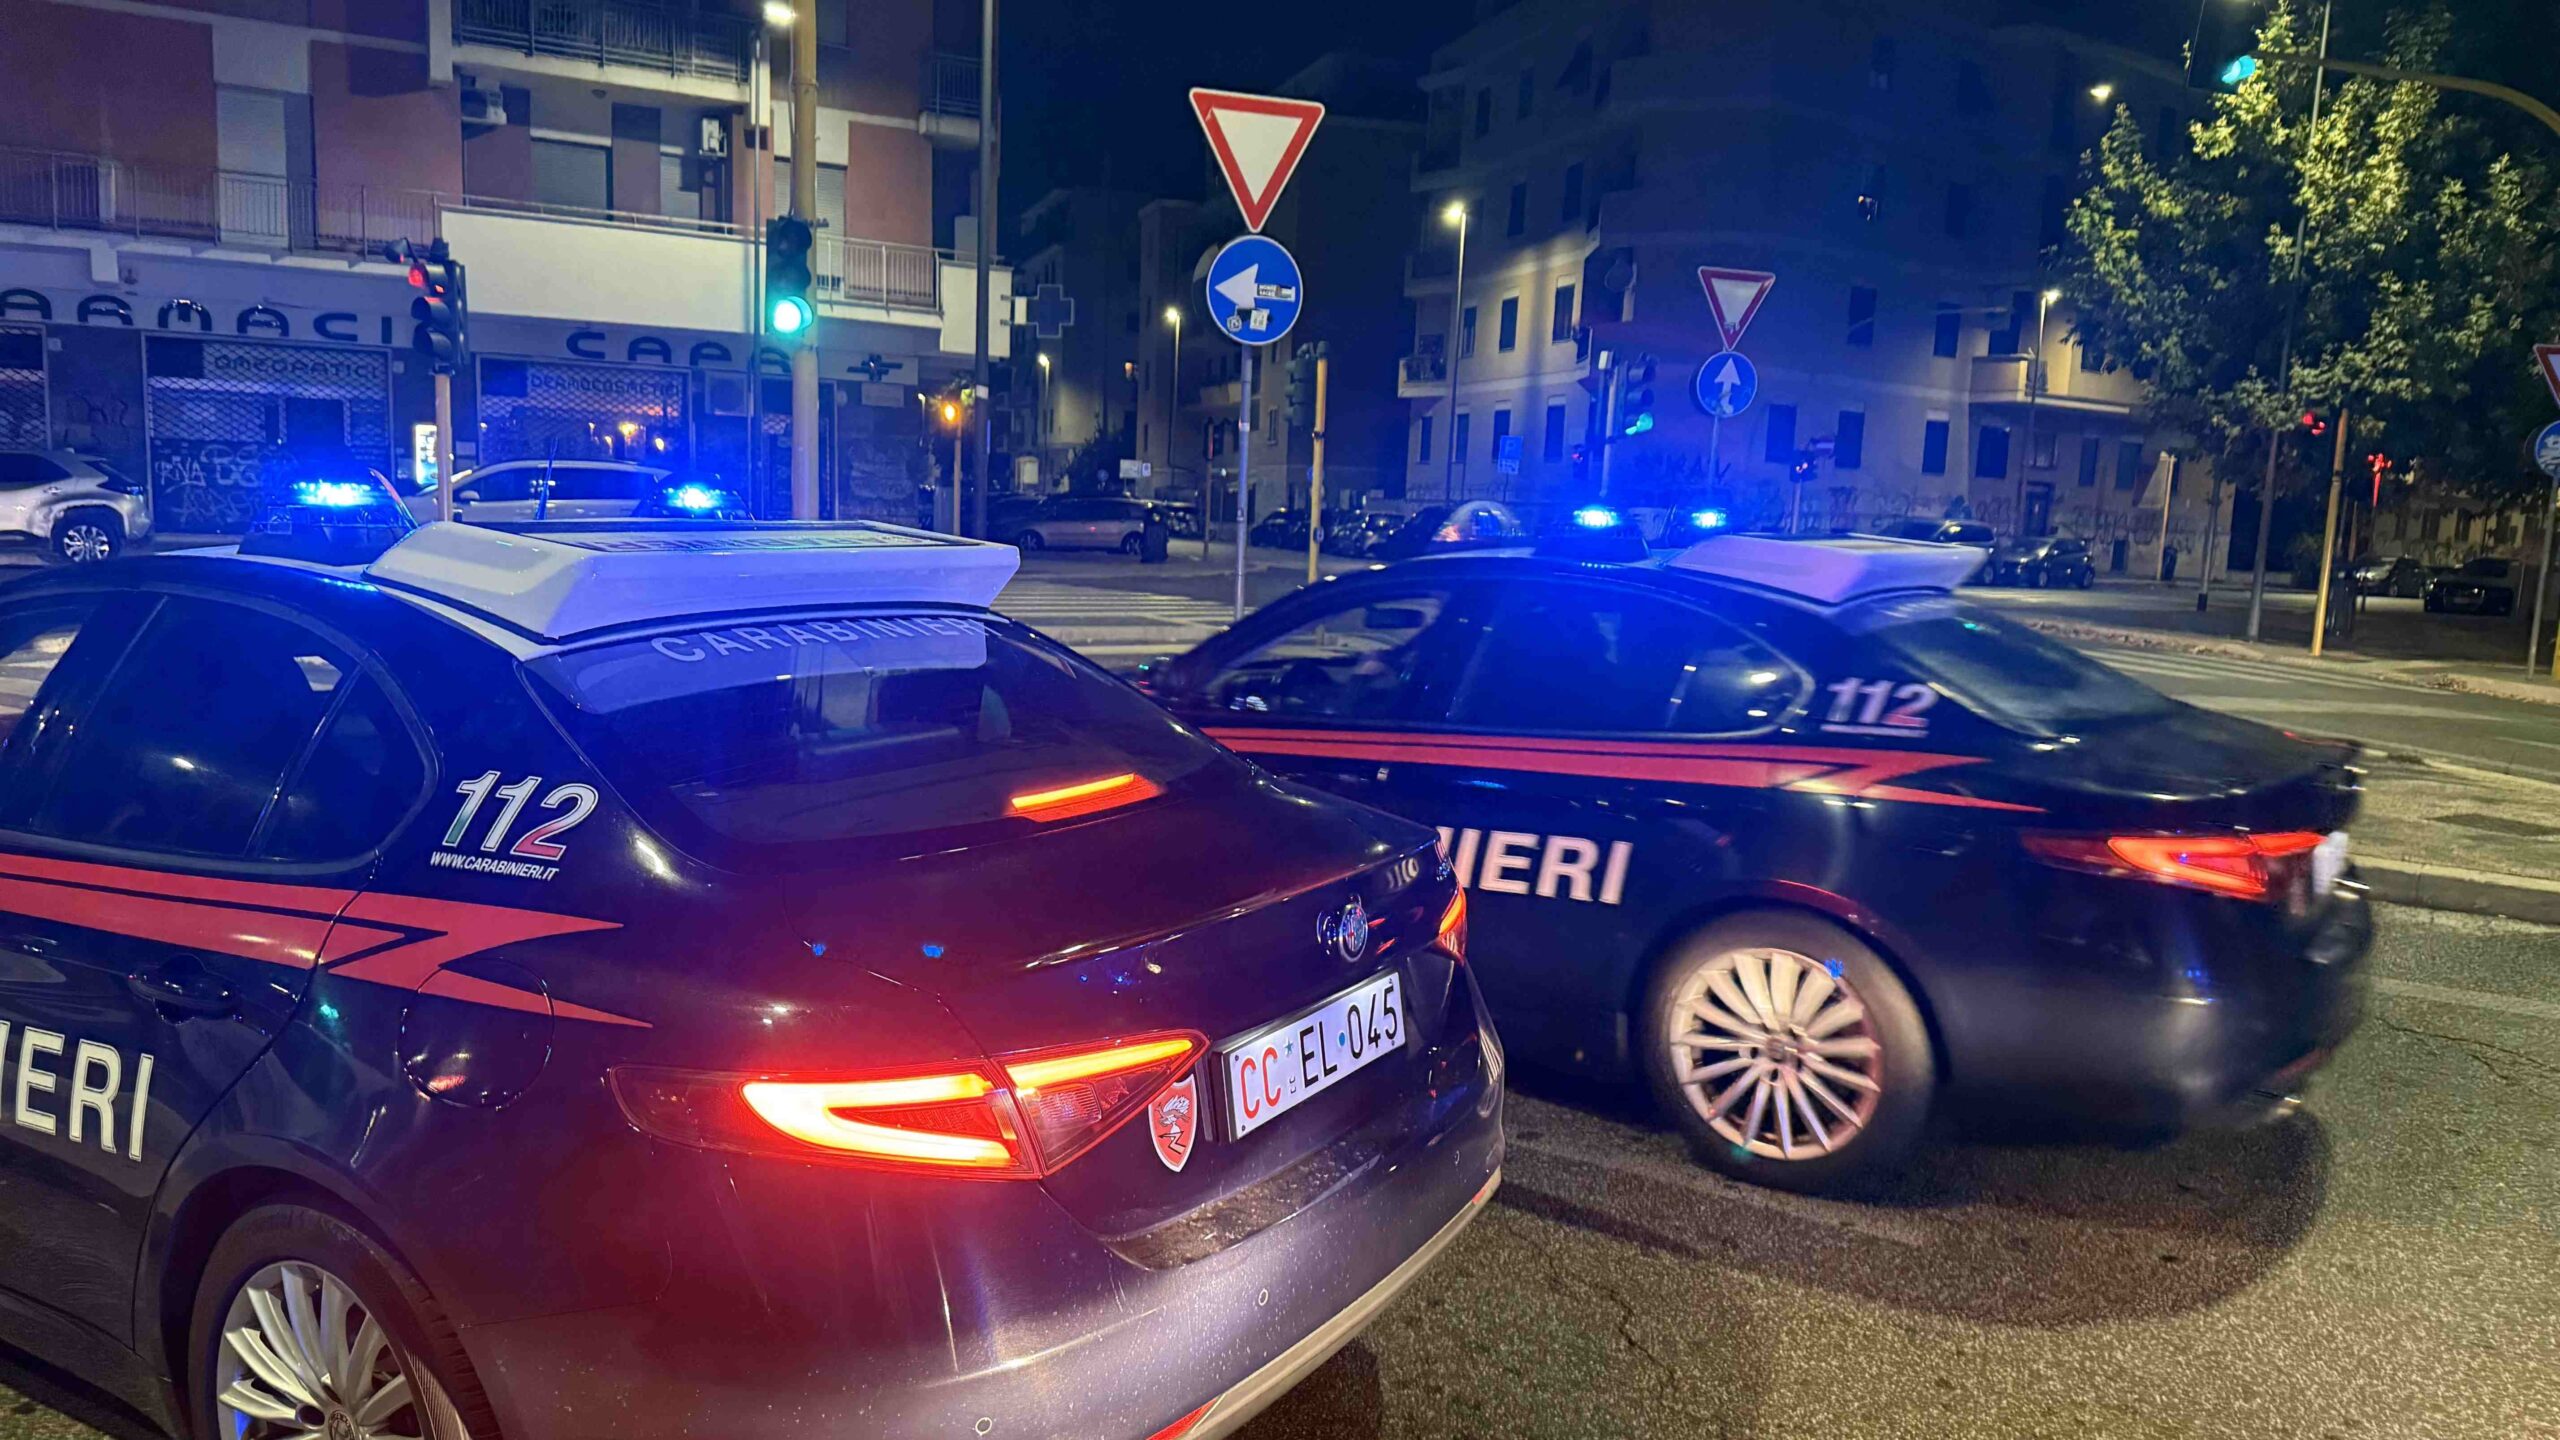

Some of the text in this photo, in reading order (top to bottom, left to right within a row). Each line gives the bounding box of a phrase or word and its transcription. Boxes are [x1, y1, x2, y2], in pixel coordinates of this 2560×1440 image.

[650, 617, 1003, 662] CARABINIERI
[1826, 677, 1939, 728] 112
[442, 770, 599, 861] 112
[430, 851, 559, 881] WWW.CARABINIERI.IT
[1240, 985, 1399, 1119] CC EL 045
